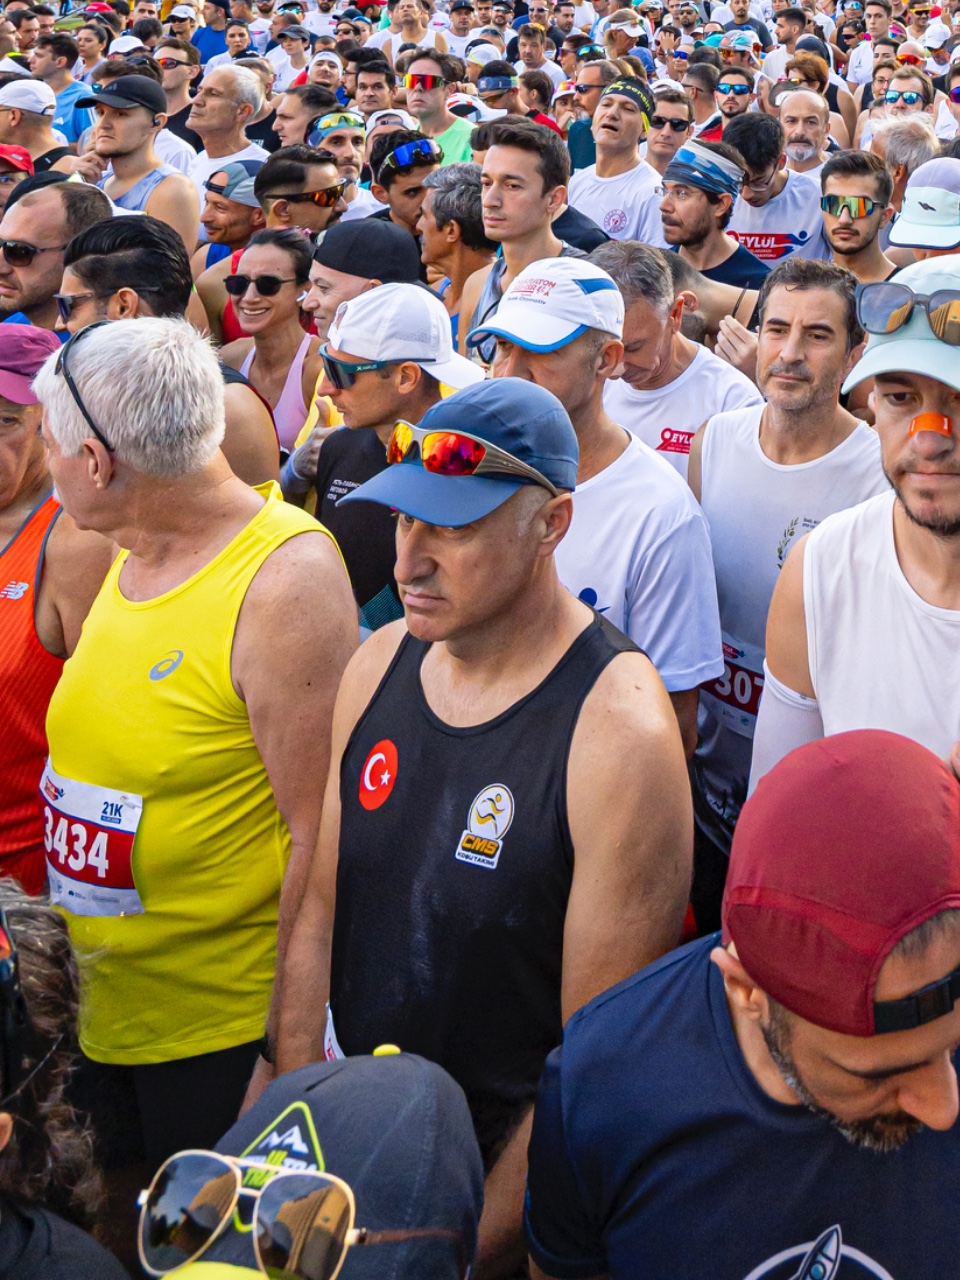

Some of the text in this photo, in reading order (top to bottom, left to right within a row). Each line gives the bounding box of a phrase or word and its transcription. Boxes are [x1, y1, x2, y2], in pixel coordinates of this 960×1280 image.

[102, 801, 123, 817] 21K
[44, 805, 109, 879] 3434
[462, 834, 499, 856] CMS
